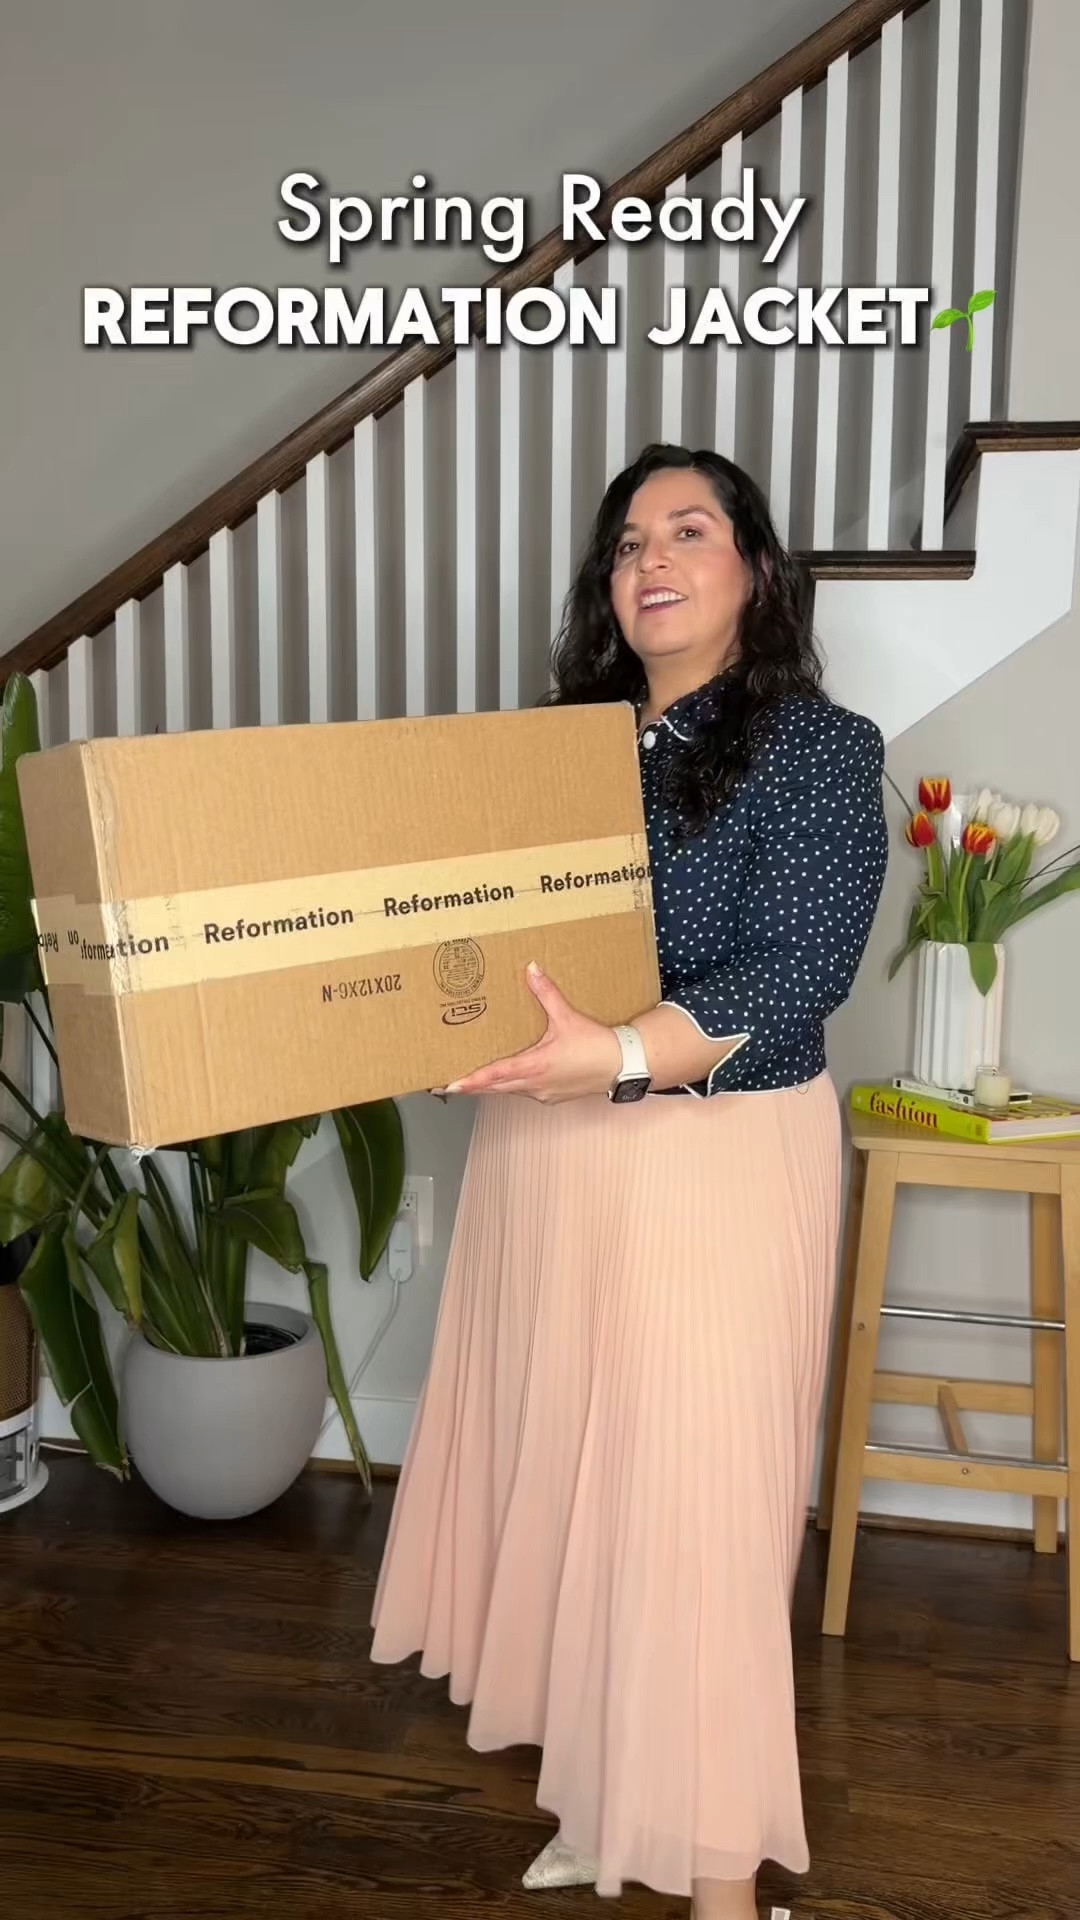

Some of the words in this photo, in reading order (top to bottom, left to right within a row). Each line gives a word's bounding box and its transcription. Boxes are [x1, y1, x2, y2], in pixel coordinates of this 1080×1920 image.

[203, 907, 354, 944] Reformation
[383, 883, 515, 918] Reformation
[322, 973, 402, 1003] 20X12X6-N
[869, 1091, 938, 1129] fashion
